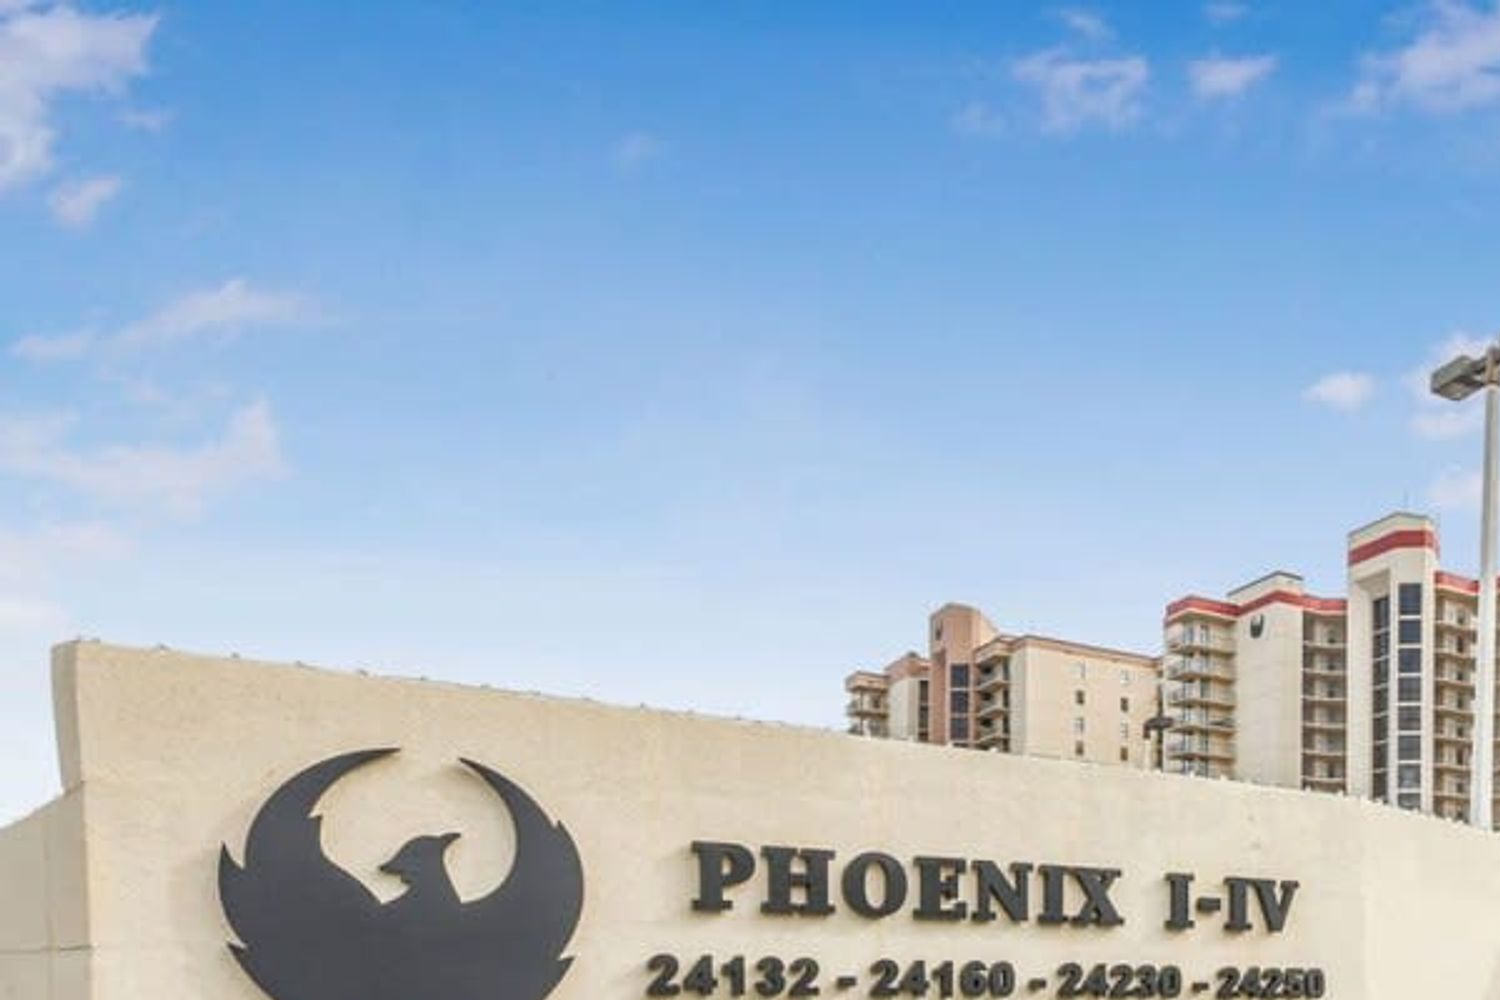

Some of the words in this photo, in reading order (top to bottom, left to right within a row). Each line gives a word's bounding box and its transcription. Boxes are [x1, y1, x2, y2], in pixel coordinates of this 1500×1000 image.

[689, 840, 1125, 930] PHOENIX
[1164, 872, 1300, 935] I-IV
[646, 954, 820, 1000] 24132
